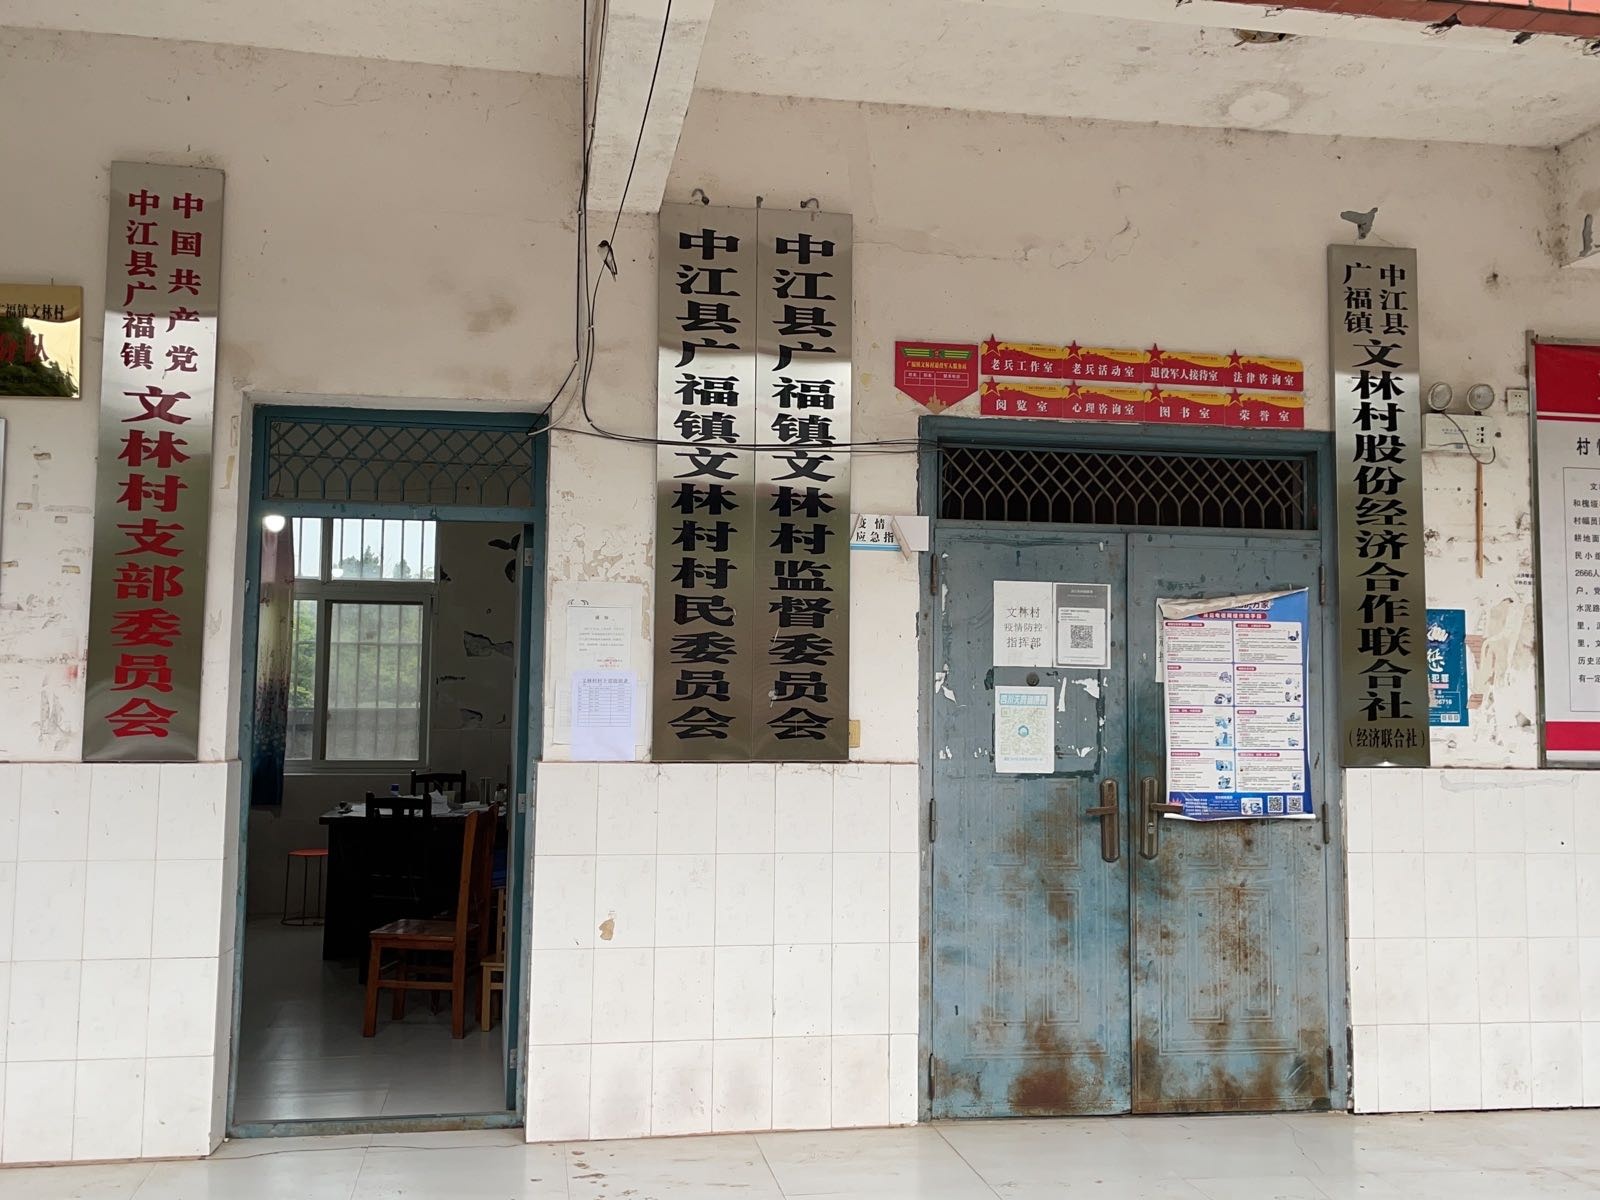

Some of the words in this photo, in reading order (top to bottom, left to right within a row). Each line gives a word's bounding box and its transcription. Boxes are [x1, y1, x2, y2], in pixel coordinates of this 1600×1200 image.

[120, 189, 160, 370] 中江县广福镇
[165, 193, 204, 372] 中国共产党
[1343, 262, 1373, 334] 广福镇
[1380, 264, 1408, 335] 中江县
[0, 303, 64, 320] 福镇文林村
[991, 358, 1053, 373] 老兵工作室
[1072, 363, 1135, 377] 老兵活动室
[1150, 367, 1218, 382] 退役军人接待室
[1233, 371, 1294, 386] 法律咨询室
[996, 399, 1048, 412] 阅览室
[1072, 403, 1135, 416] 心理咨询室
[1159, 406, 1211, 419] 图书室
[1239, 409, 1291, 422] 荣誉室
[1577, 437, 1600, 455] 村
[667, 228, 741, 740] 中江县广福镇文林村村民委员会
[767, 233, 836, 740] 中江县广福镇文林村监督委员会
[1574, 517, 1600, 525] 村幅员
[1351, 339, 1414, 721] 文林村股份经济合作联合社
[105, 385, 192, 739] 文林村支部委员会
[1006, 606, 1041, 618] 文林村
[1004, 622, 1043, 633] 疫情防控
[1006, 637, 1041, 649] 指挥部
[1427, 673, 1450, 683] 犯罪
